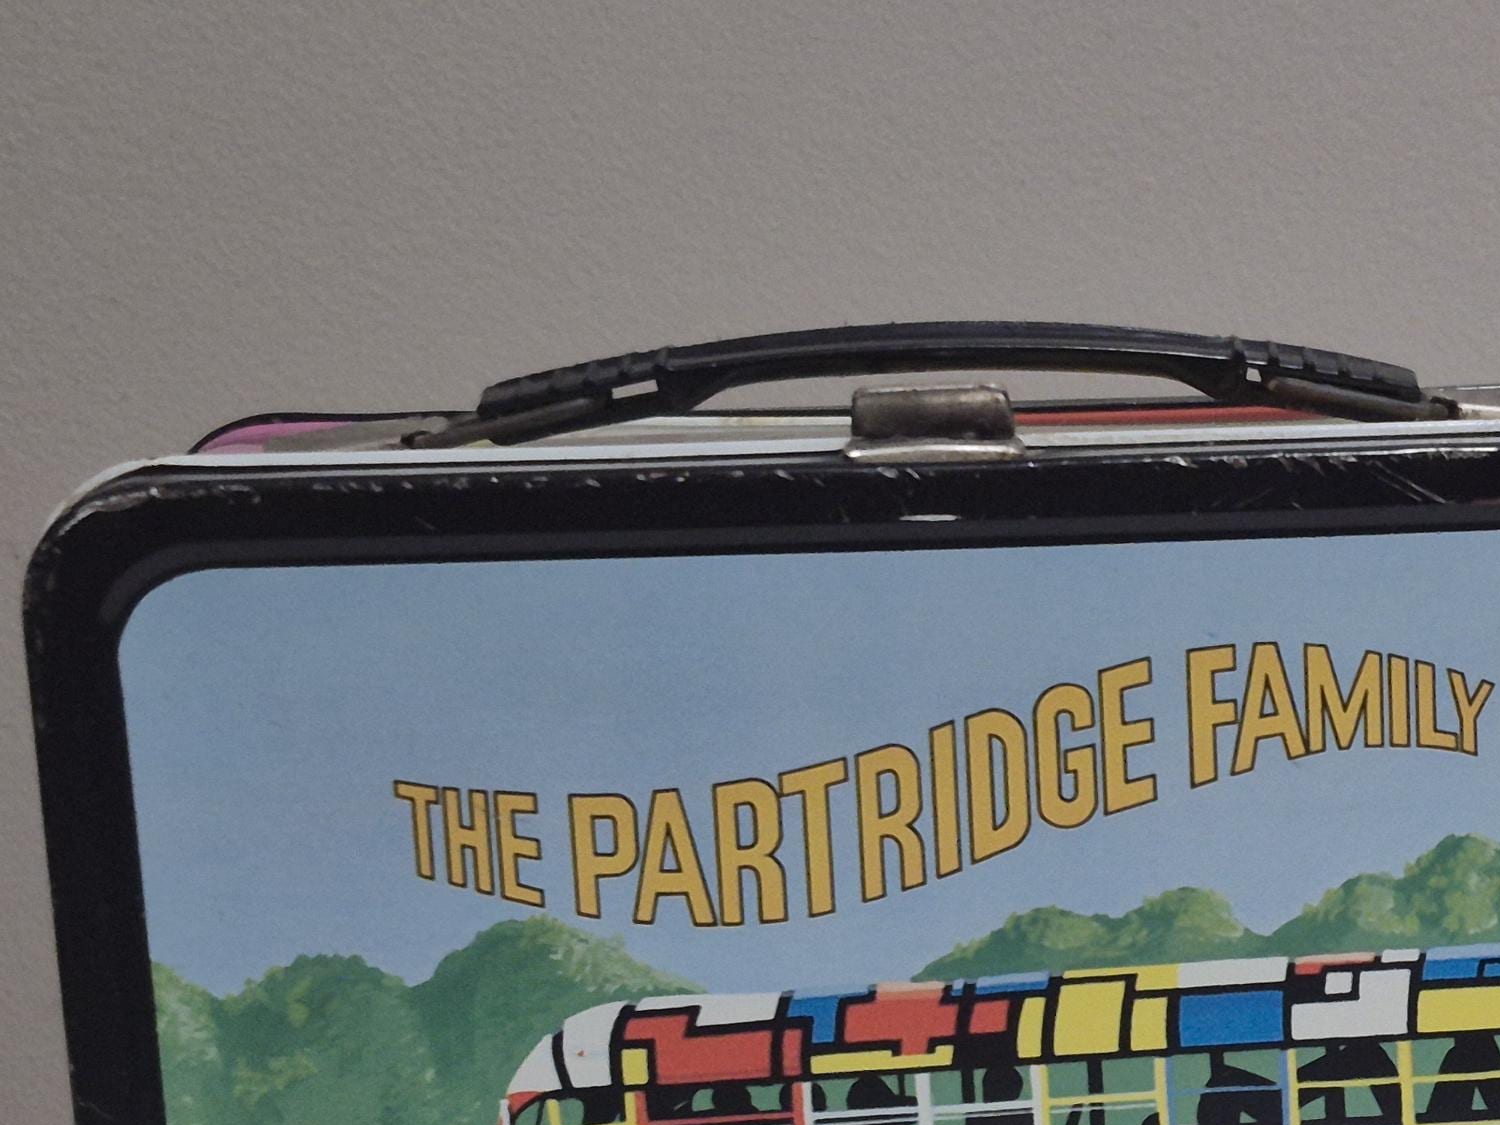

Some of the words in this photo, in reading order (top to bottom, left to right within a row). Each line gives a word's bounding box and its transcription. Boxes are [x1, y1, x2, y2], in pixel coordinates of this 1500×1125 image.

[393, 779, 545, 908] THE
[568, 657, 1158, 927] PARTRIDGE
[1186, 641, 1495, 789] FAMILY
